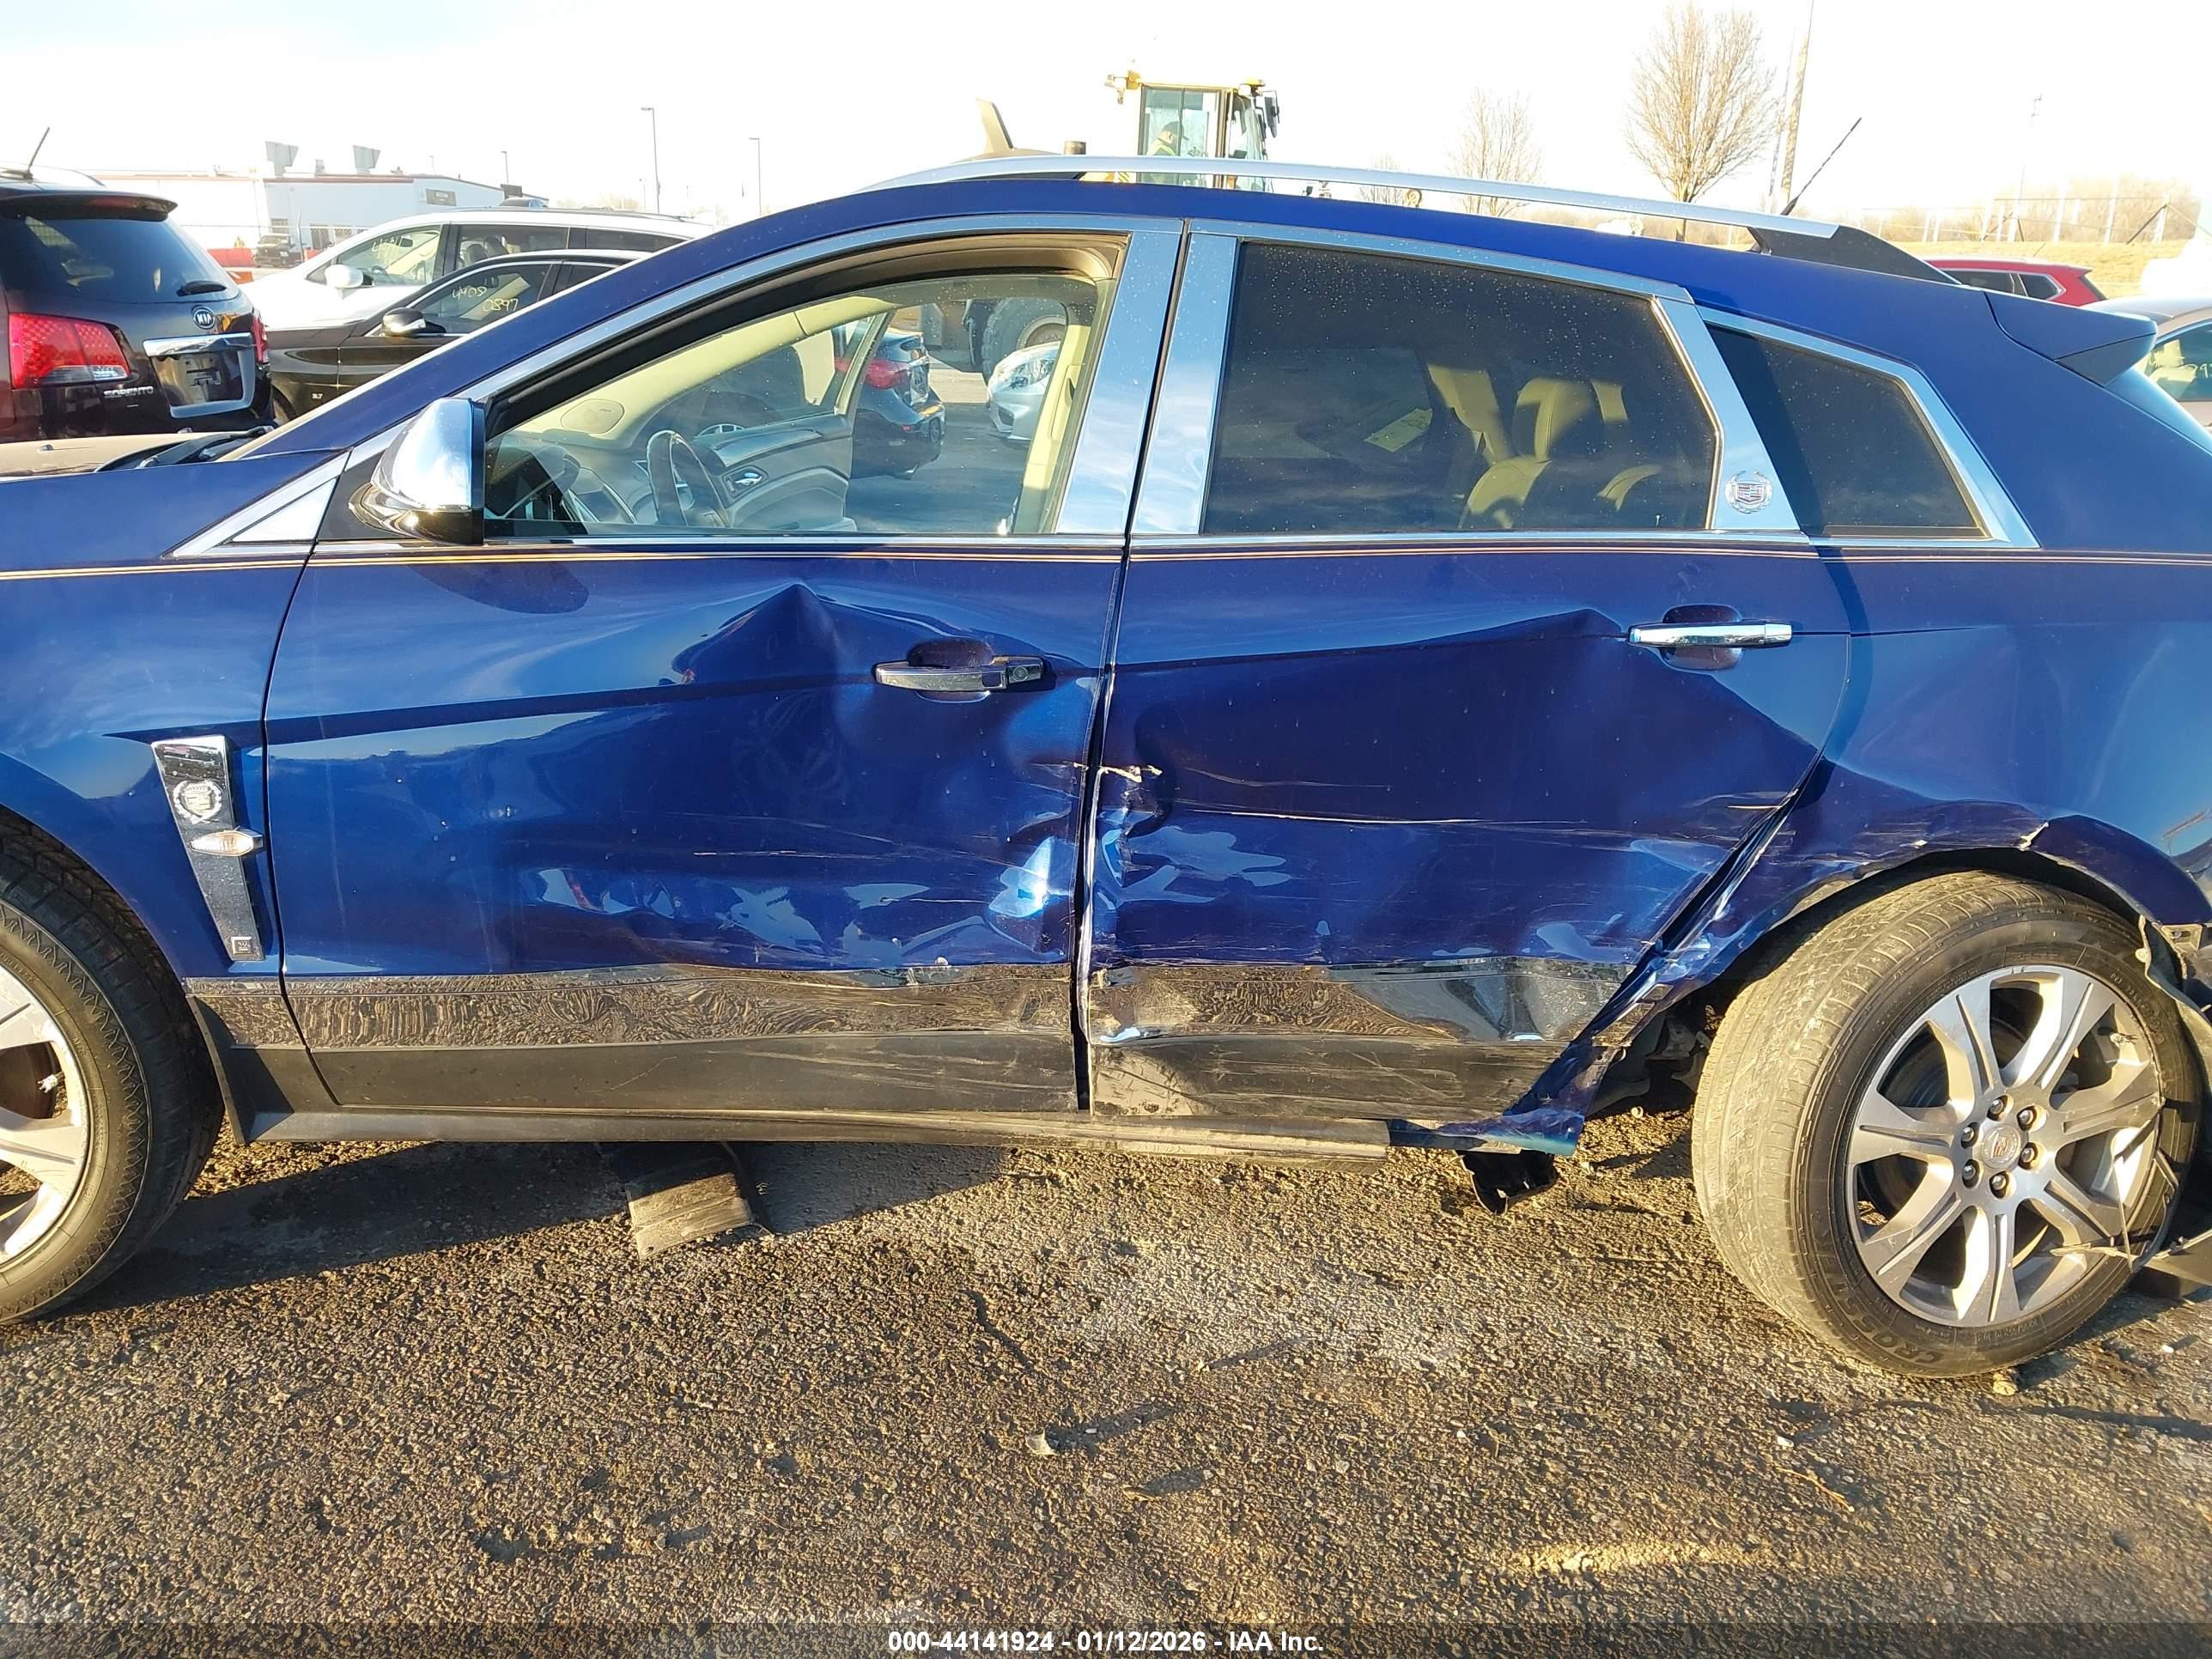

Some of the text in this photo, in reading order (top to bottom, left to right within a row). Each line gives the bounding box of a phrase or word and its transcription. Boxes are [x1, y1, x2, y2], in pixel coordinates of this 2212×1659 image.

[452, 286, 488, 300] 4408
[483, 297, 519, 312] 0897
[196, 309, 212, 325] KIA
[103, 386, 154, 398] SORENTO
